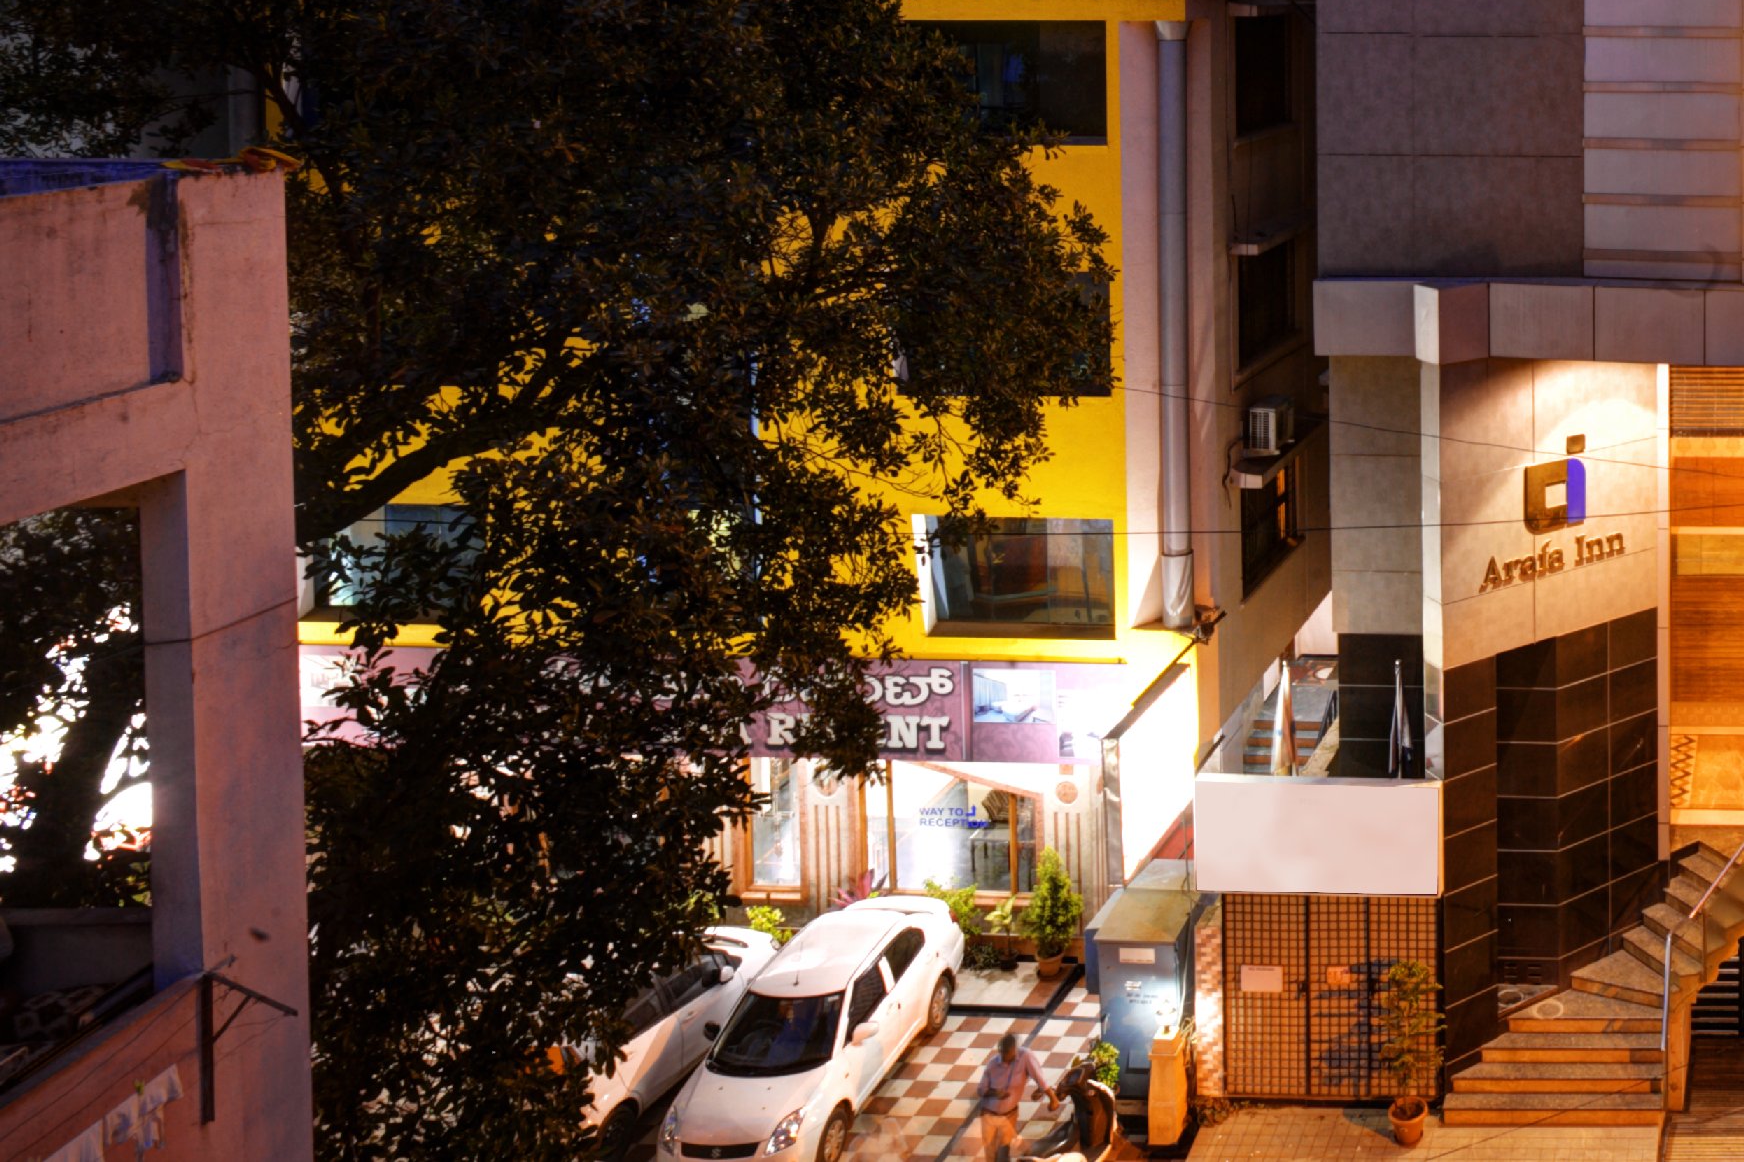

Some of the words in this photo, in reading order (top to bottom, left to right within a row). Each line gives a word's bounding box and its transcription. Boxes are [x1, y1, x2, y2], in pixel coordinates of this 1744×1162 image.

[1479, 539, 1566, 593] Arafa
[1575, 532, 1626, 567] Inn
[920, 807, 943, 816] WAY
[948, 807, 964, 816] TO
